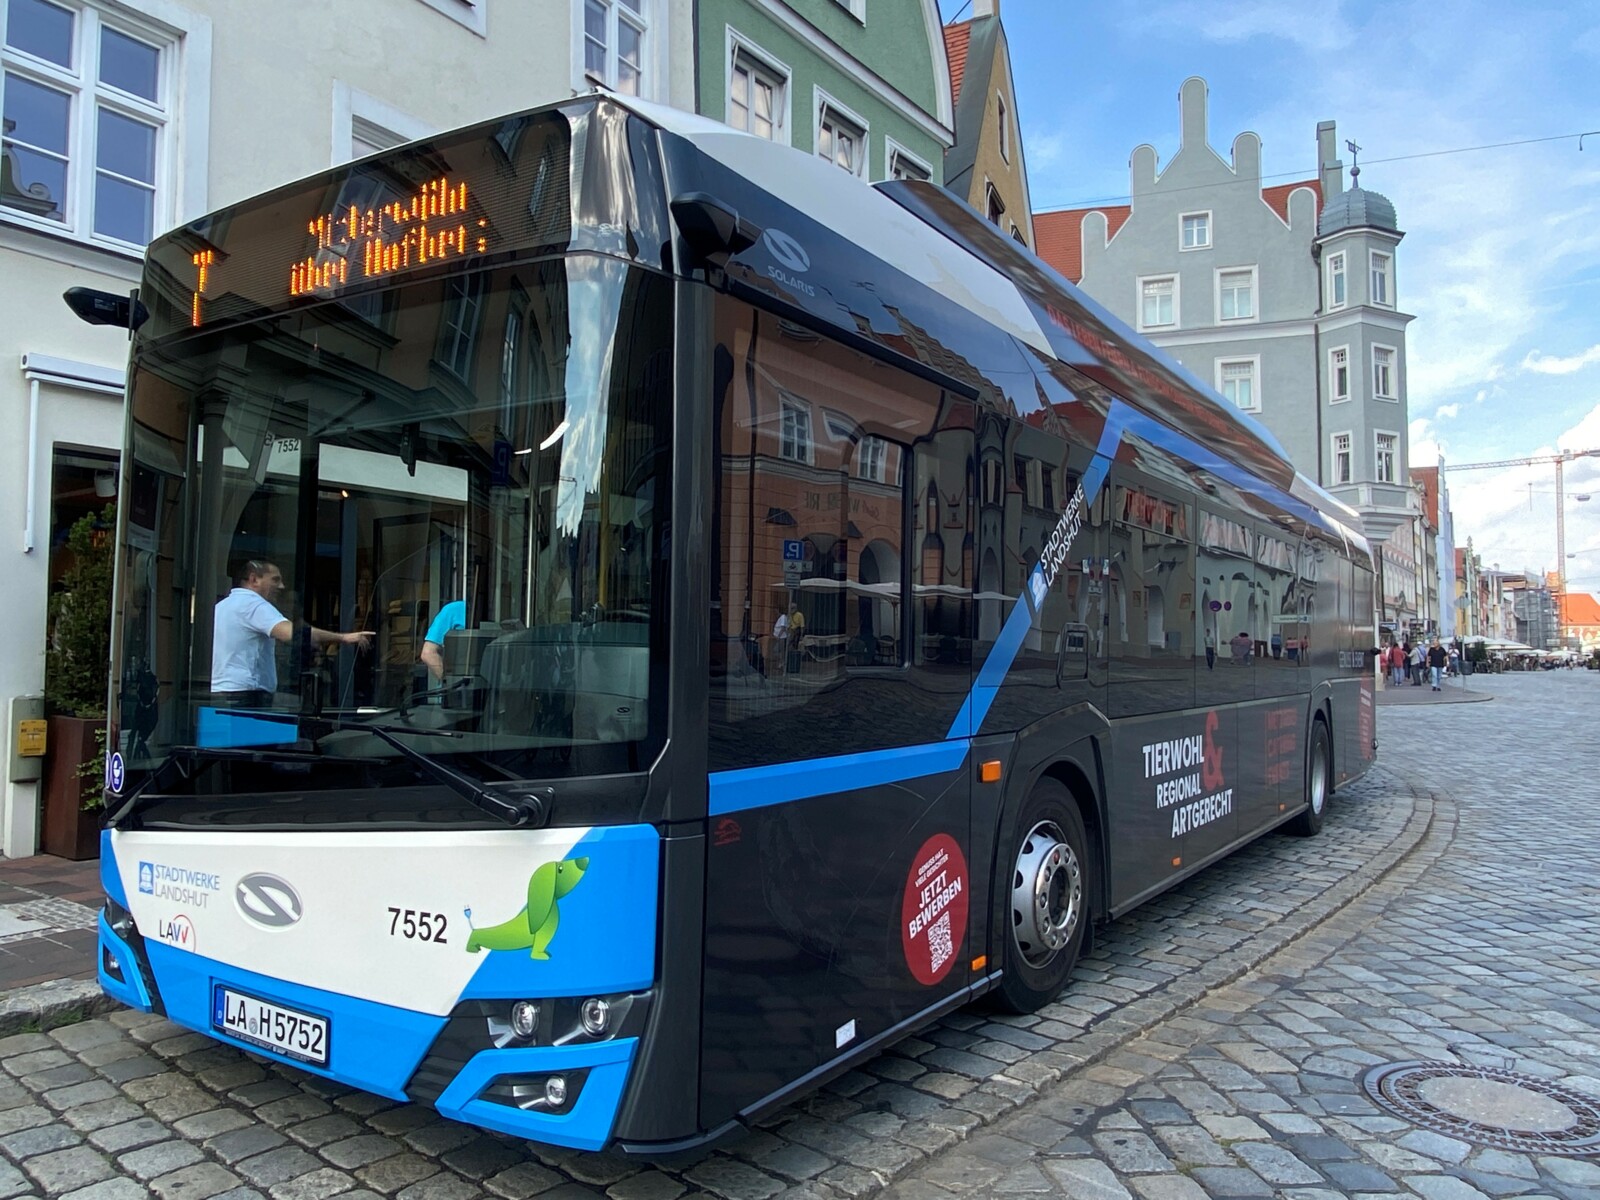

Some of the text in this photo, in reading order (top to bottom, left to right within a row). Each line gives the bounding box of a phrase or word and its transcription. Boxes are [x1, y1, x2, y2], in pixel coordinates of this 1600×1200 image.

[767, 265, 815, 297] SOLARIS
[277, 438, 299, 454] 7552
[1041, 483, 1084, 570] STADTWERKE
[1045, 510, 1082, 587] LANDSHUT
[1142, 734, 1205, 779] TIERWOHL
[1203, 709, 1225, 792] &
[1156, 772, 1202, 809] REGIONAL
[1171, 788, 1233, 838] ARTGERECHT
[155, 864, 220, 891] STADTWERKE
[155, 882, 209, 909] LANDSHUT
[919, 870, 946, 908] JETZT
[387, 906, 448, 945] 7552
[909, 877, 962, 939] BEWERBEN
[225, 995, 248, 1031] LA
